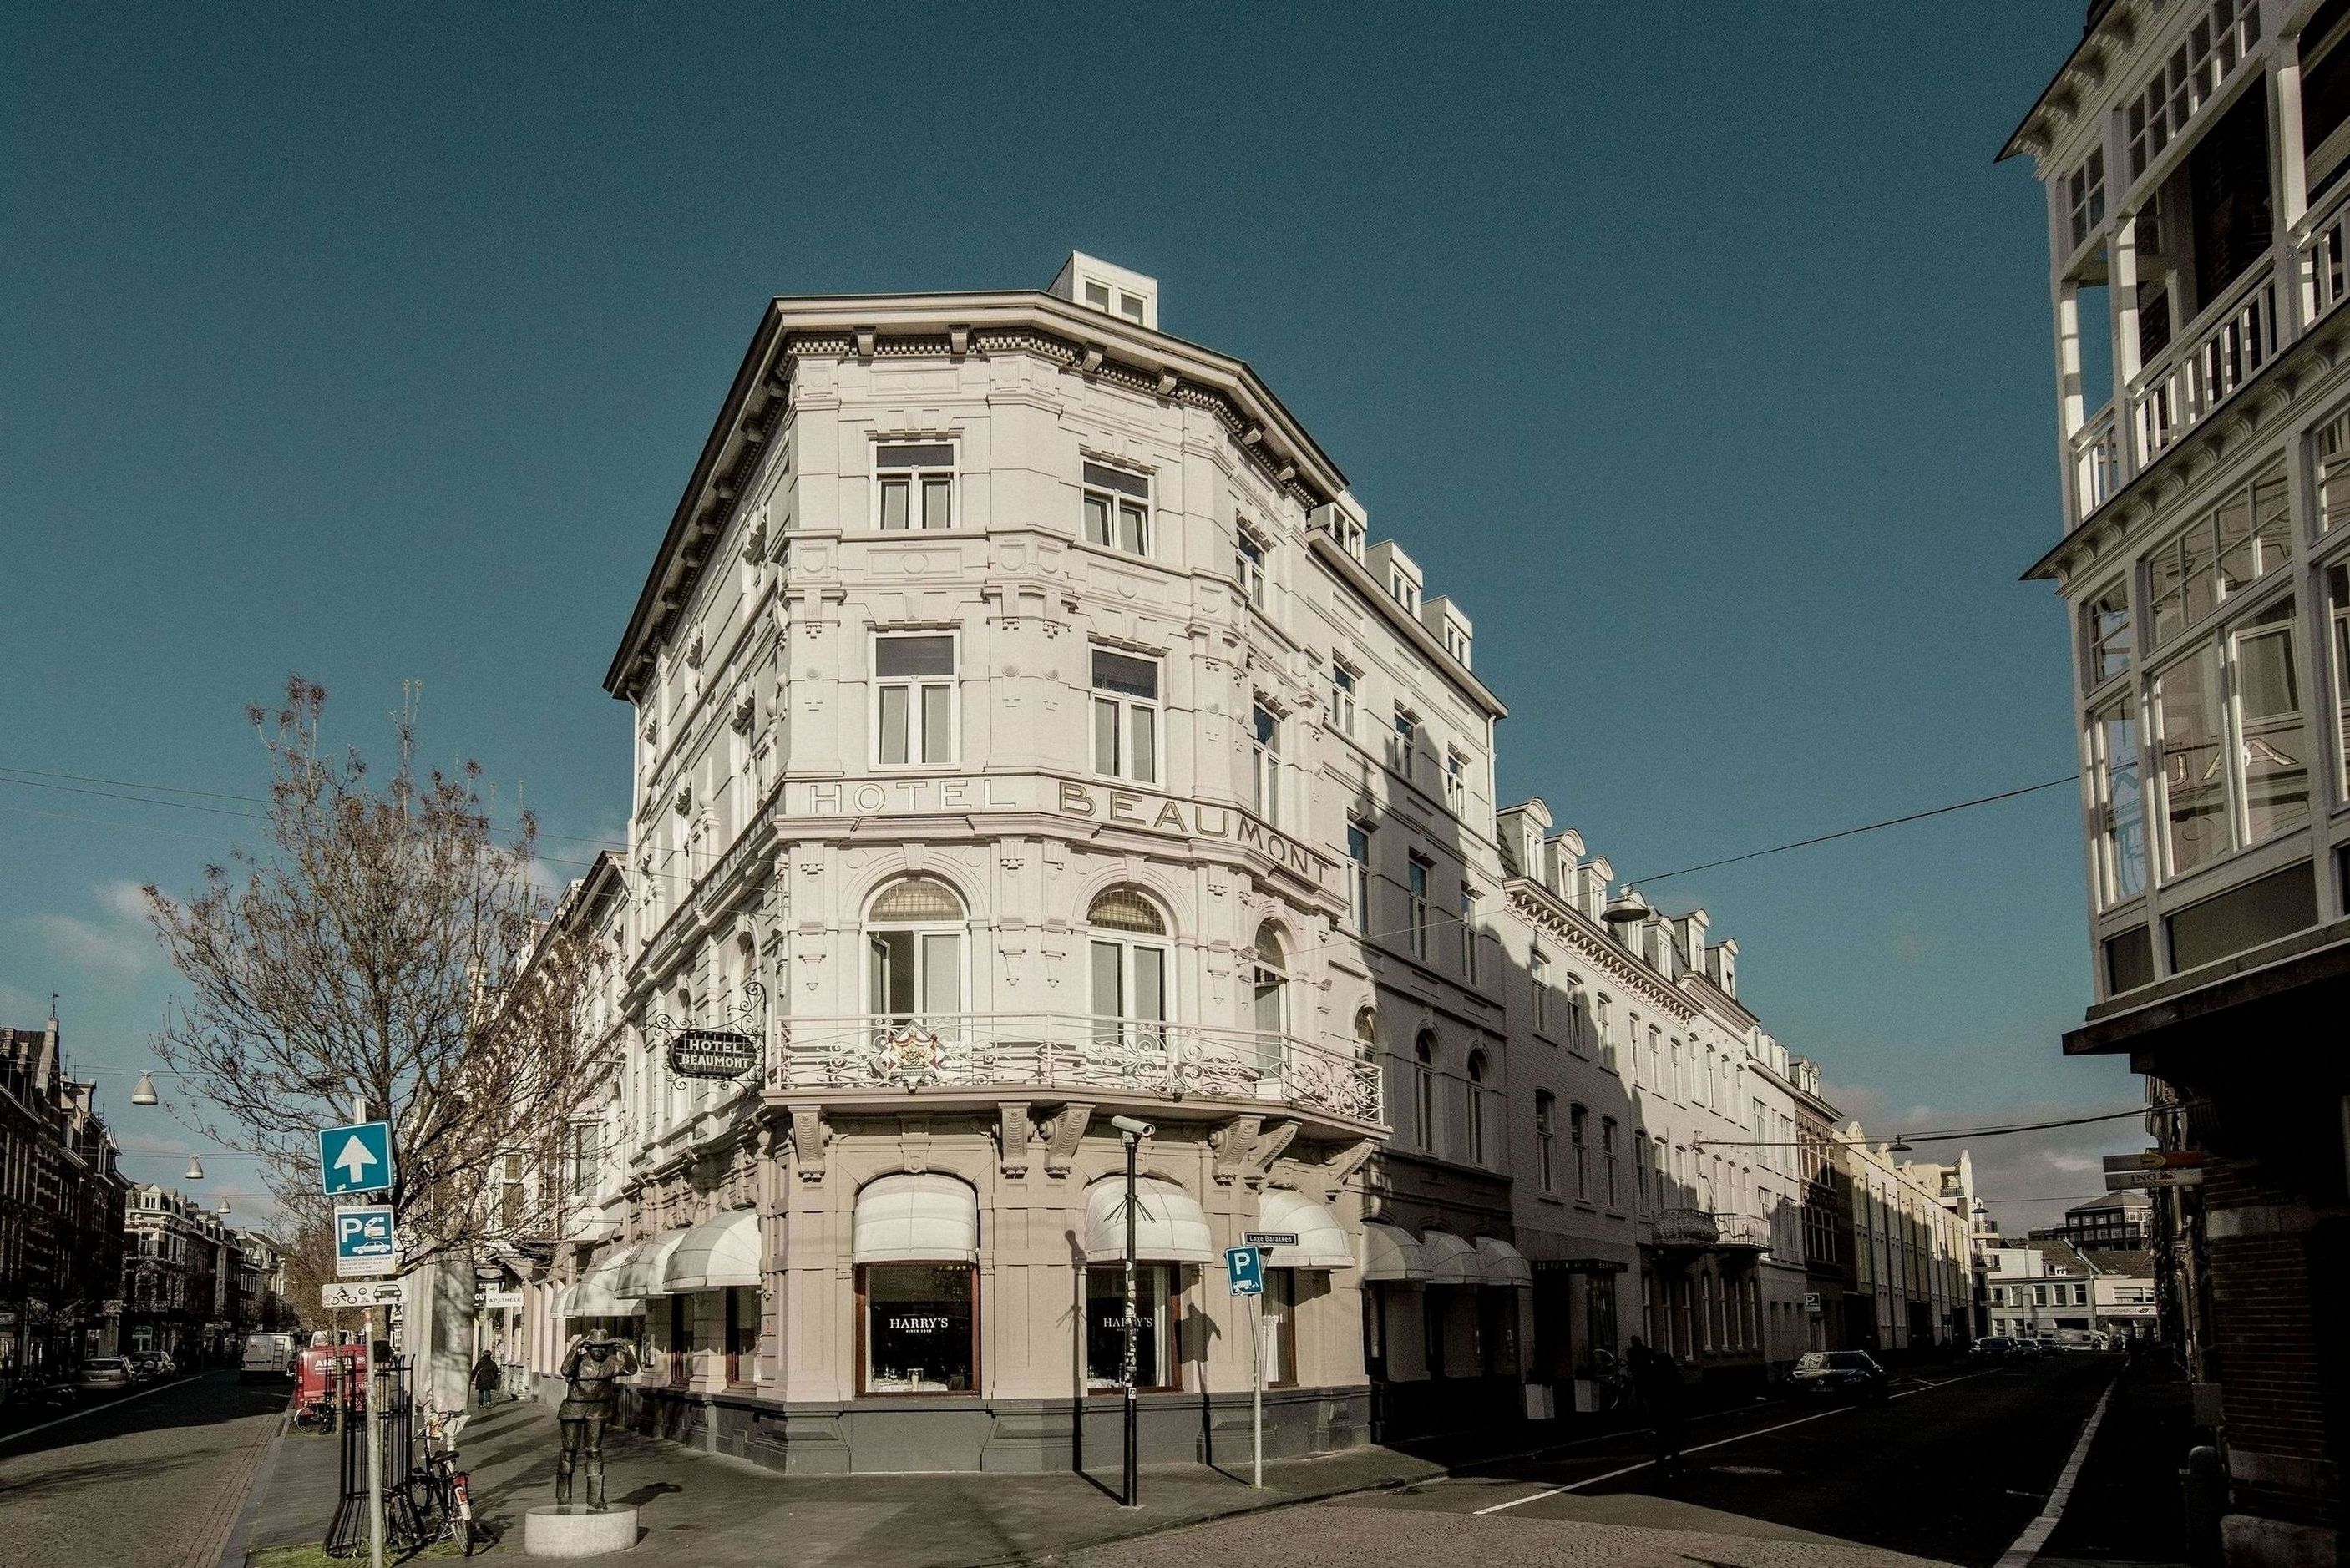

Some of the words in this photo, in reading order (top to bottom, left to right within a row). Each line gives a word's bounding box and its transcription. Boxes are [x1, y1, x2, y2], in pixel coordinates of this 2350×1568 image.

[808, 779, 1018, 815] HOTEL
[1058, 780, 1329, 884] BEAUMONT
[689, 1039, 742, 1053] HOTEL
[681, 1054, 750, 1068] BEAUMONT
[2130, 1173, 2156, 1181] ING
[340, 1218, 363, 1243] P
[1233, 1252, 1251, 1275] P
[889, 1317, 949, 1328] HARRY'S
[1102, 1317, 1153, 1328] HAY'S
